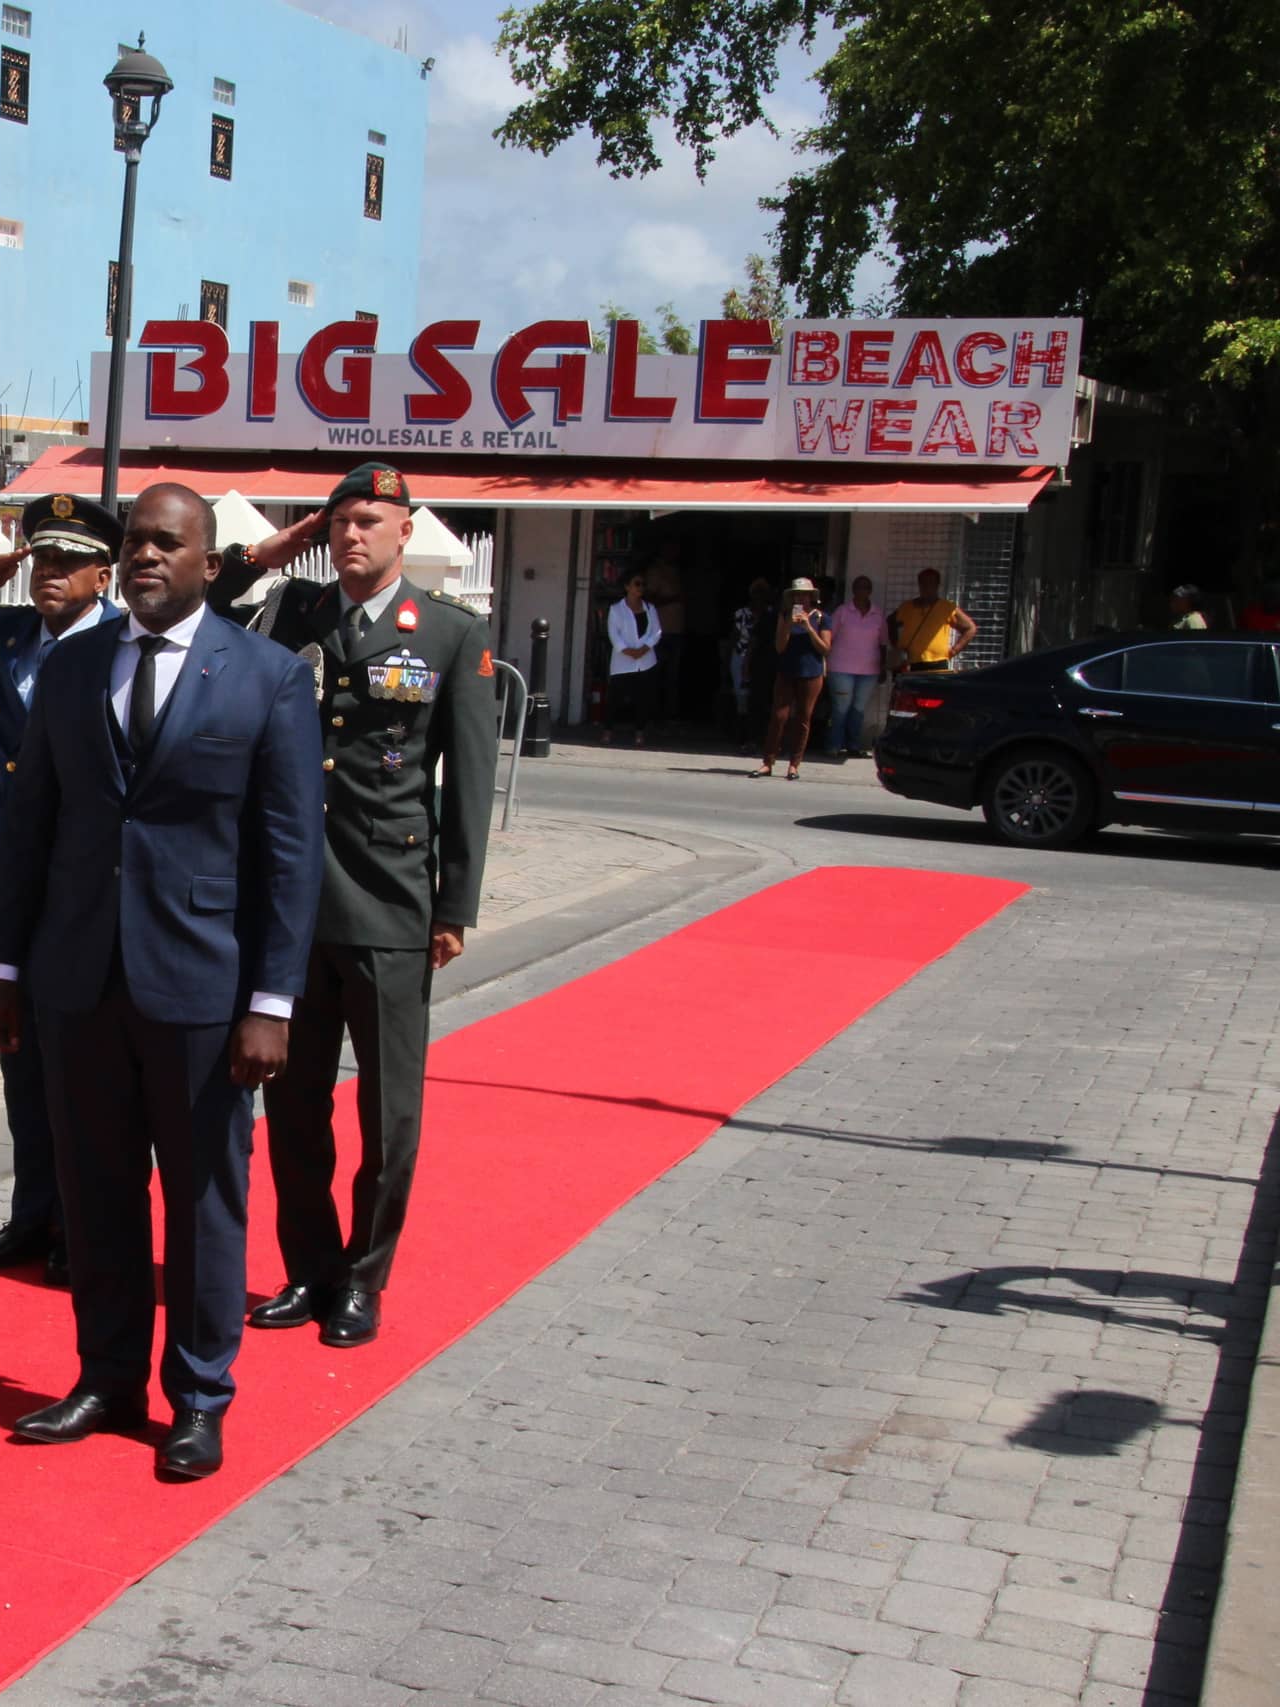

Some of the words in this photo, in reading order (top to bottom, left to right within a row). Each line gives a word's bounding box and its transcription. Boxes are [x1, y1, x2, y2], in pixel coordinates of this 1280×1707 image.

[138, 320, 379, 424] BIG
[405, 319, 774, 429] SALE
[788, 330, 1069, 388] BEACH
[327, 428, 453, 448] WHOLESALE
[462, 430, 474, 447] &
[482, 431, 558, 449] RETAIL
[794, 397, 1041, 456] WEAR
